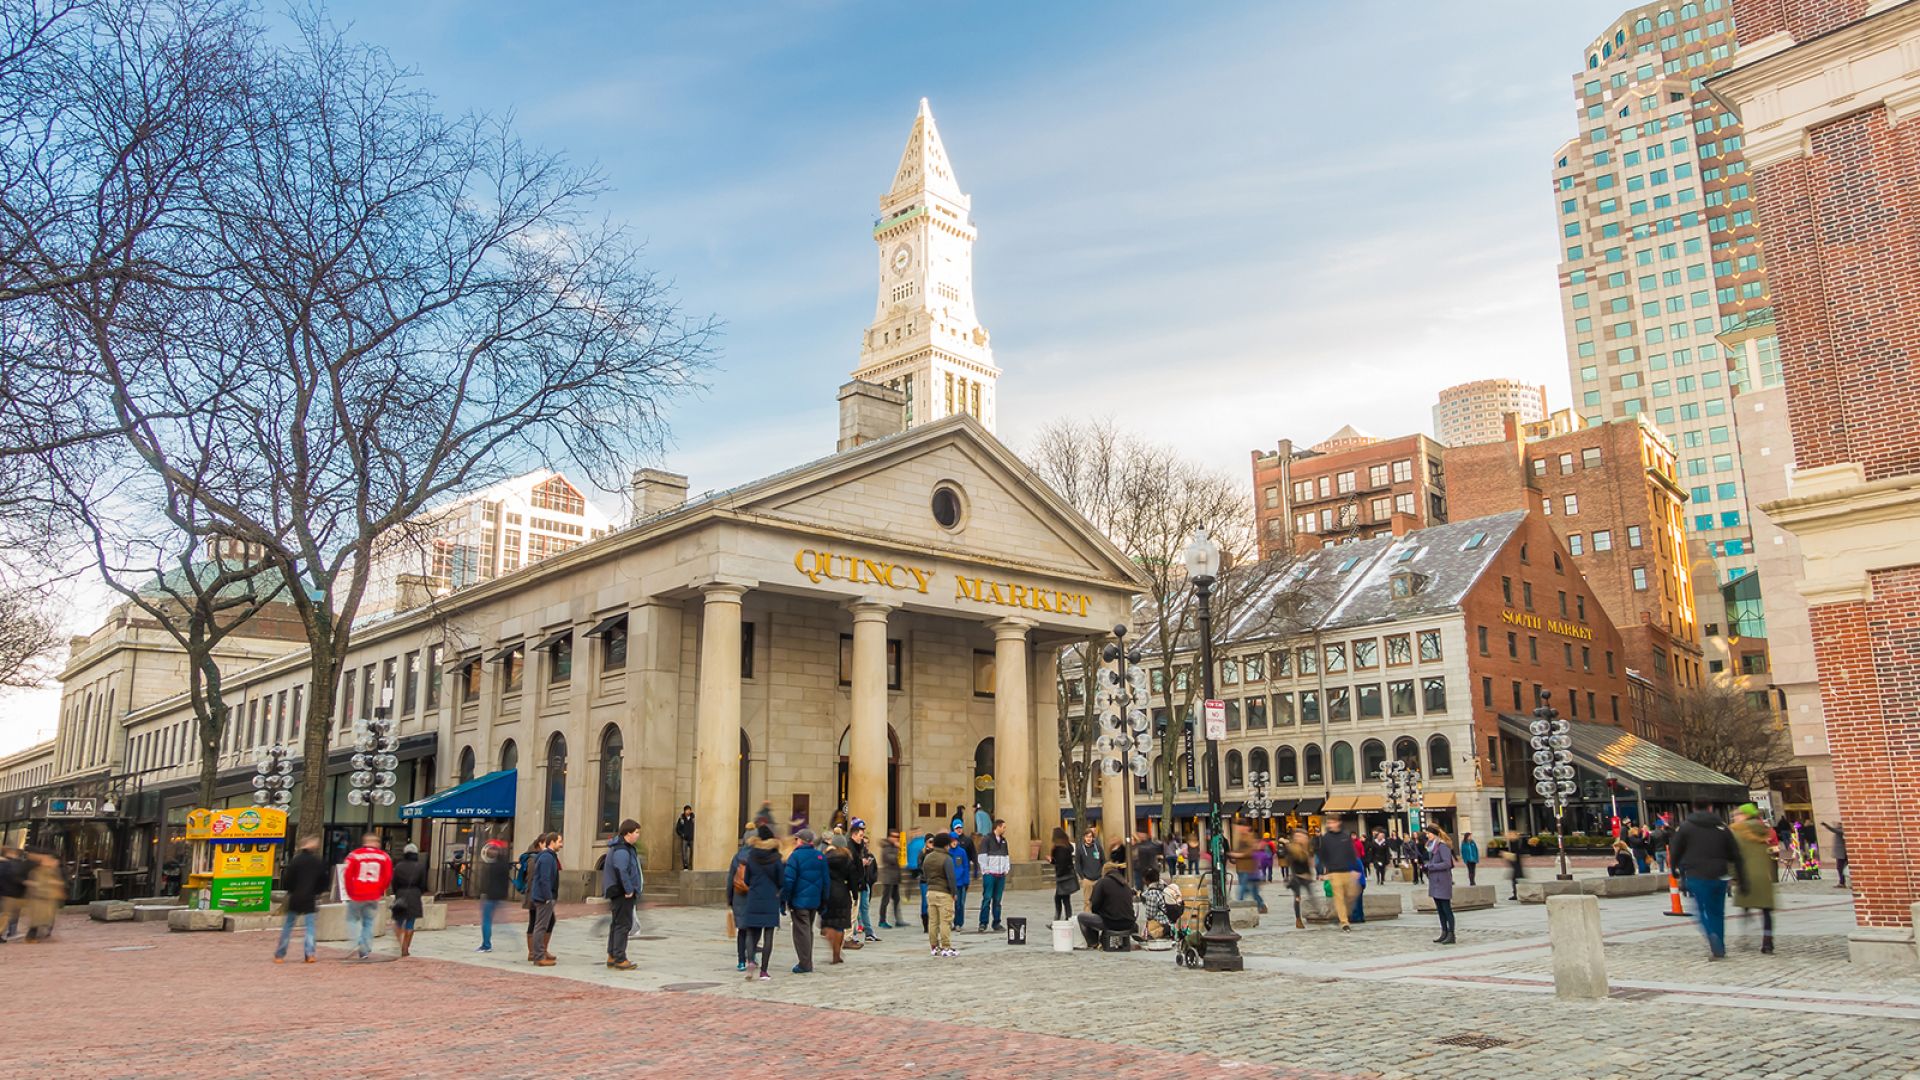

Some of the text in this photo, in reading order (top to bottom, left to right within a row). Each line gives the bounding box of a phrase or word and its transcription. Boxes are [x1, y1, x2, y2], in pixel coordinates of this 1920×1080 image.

[794, 549, 1092, 618] QUINCY MARKET
[1502, 610, 1593, 640] SOUTH MARKET
[455, 807, 475, 815] SALTY
[476, 807, 492, 815] DOG
